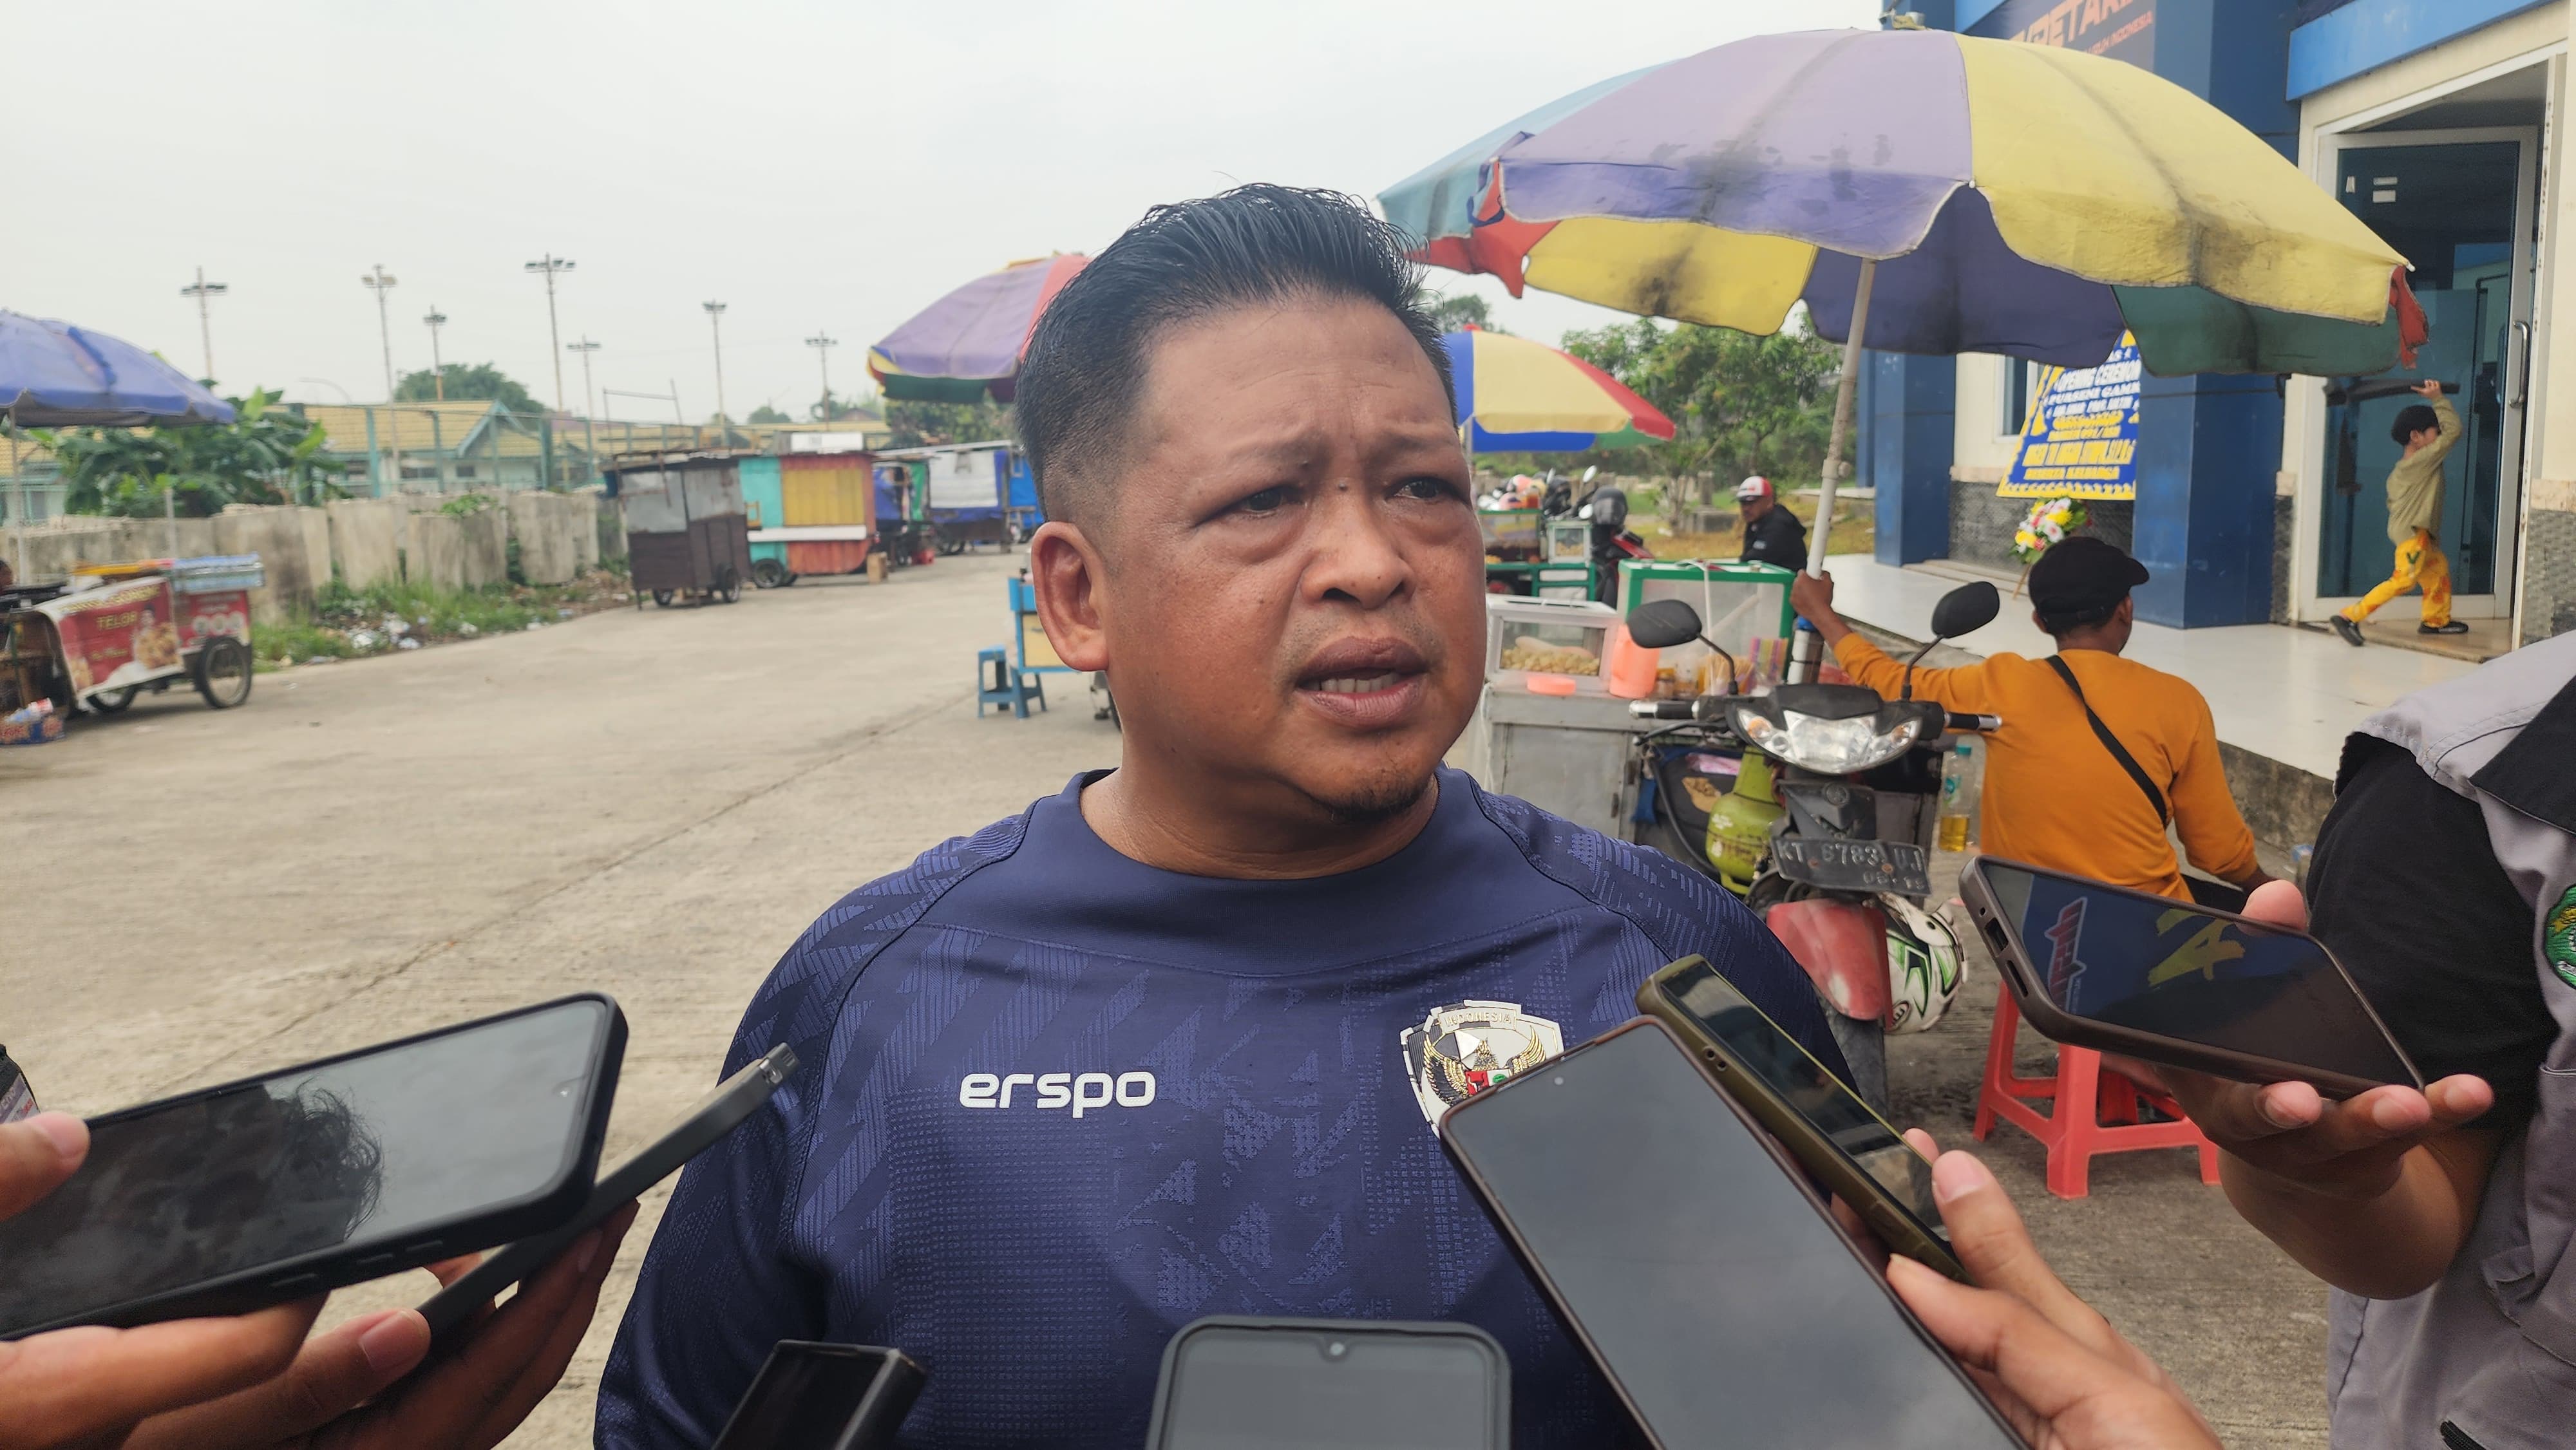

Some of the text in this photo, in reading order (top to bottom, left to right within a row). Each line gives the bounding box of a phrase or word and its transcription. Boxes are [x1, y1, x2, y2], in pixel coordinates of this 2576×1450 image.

[1776, 840, 1803, 863] KT
[1445, 1012, 1511, 1026] INDONESIA
[960, 1071, 1156, 1118] erspo
